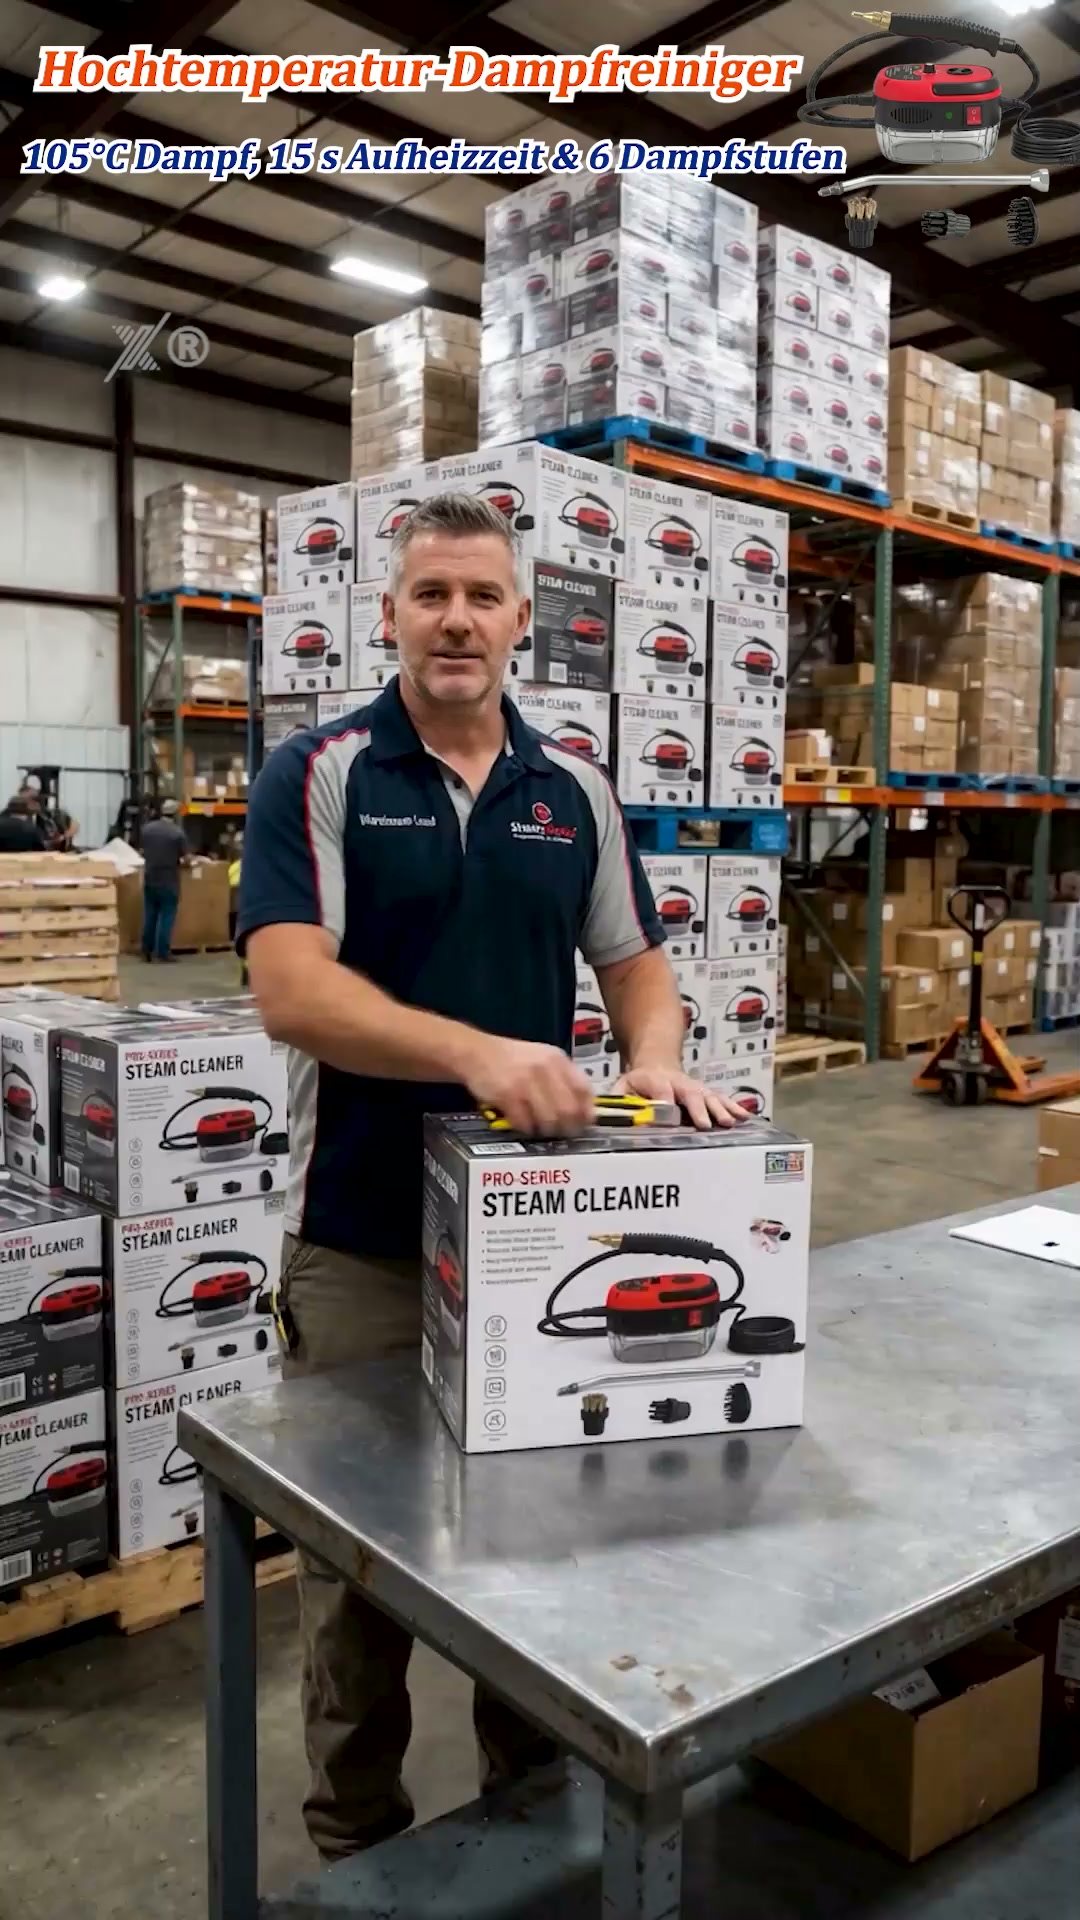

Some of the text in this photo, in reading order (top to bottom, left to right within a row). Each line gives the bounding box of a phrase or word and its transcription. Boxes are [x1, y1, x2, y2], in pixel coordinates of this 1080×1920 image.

[125, 1054, 244, 1081] STEAM CLEANER
[481, 1169, 571, 1188] PRO-SERIES
[482, 1184, 680, 1218] STEAM CLEANER
[30, 1237, 84, 1259] CLEANER
[122, 1217, 238, 1253] STEAM CLEANER
[125, 1397, 175, 1424] STEAM
[35, 1412, 88, 1438] CLEANER
